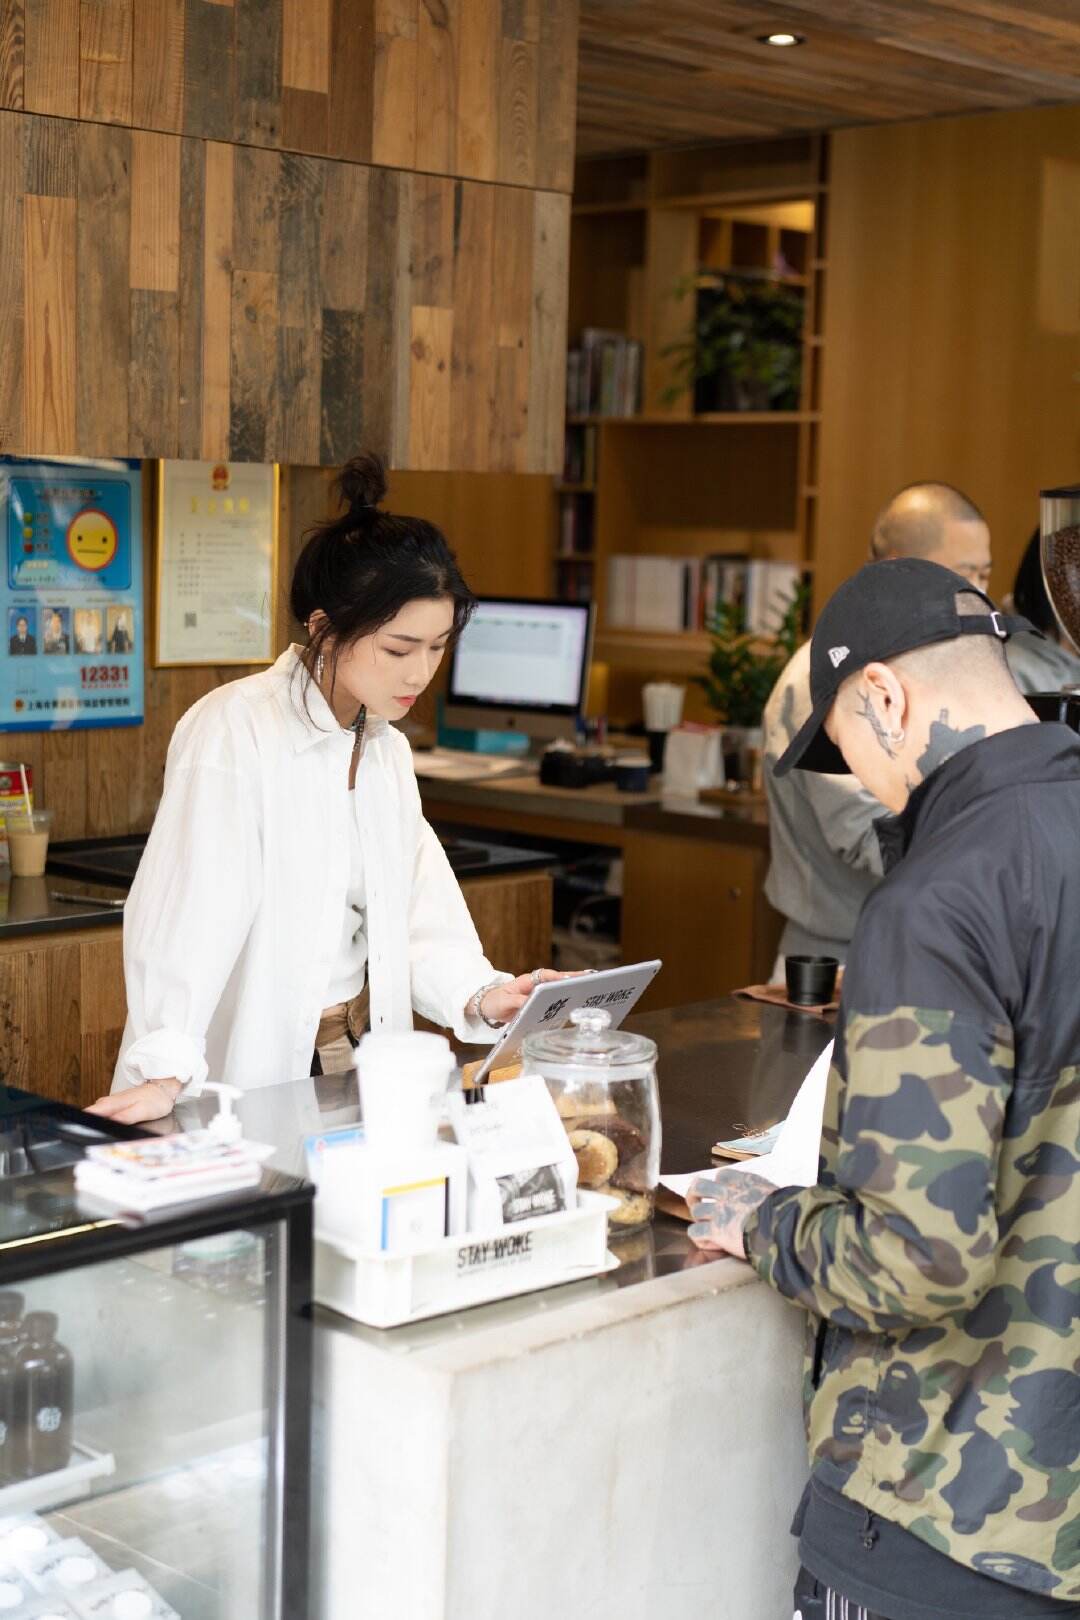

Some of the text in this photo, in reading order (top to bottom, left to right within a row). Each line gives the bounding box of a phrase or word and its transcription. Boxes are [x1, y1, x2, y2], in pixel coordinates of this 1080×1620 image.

[80, 665, 129, 682] 12331
[581, 993, 607, 1009] STAY
[606, 986, 636, 1003] WOKE
[457, 1240, 488, 1269] STAY
[494, 1230, 534, 1259] WOKE
